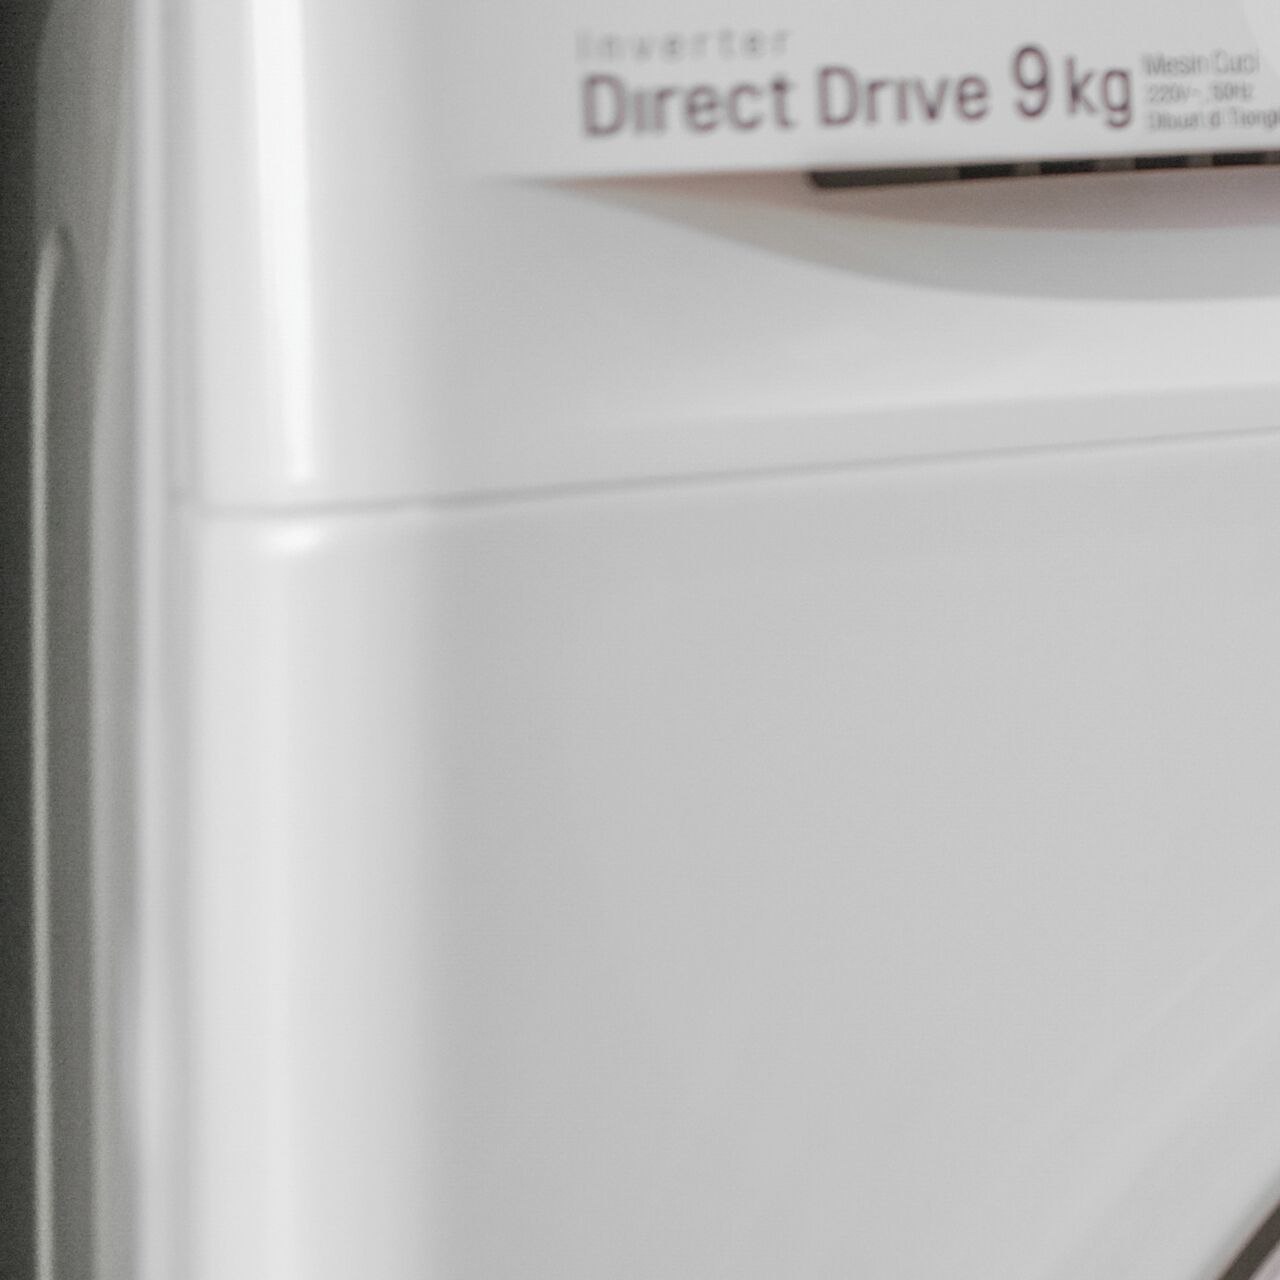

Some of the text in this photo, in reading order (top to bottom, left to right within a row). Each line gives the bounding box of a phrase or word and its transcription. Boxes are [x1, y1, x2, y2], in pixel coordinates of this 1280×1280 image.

[582, 45, 1134, 138] Direct Drive 9 kg
